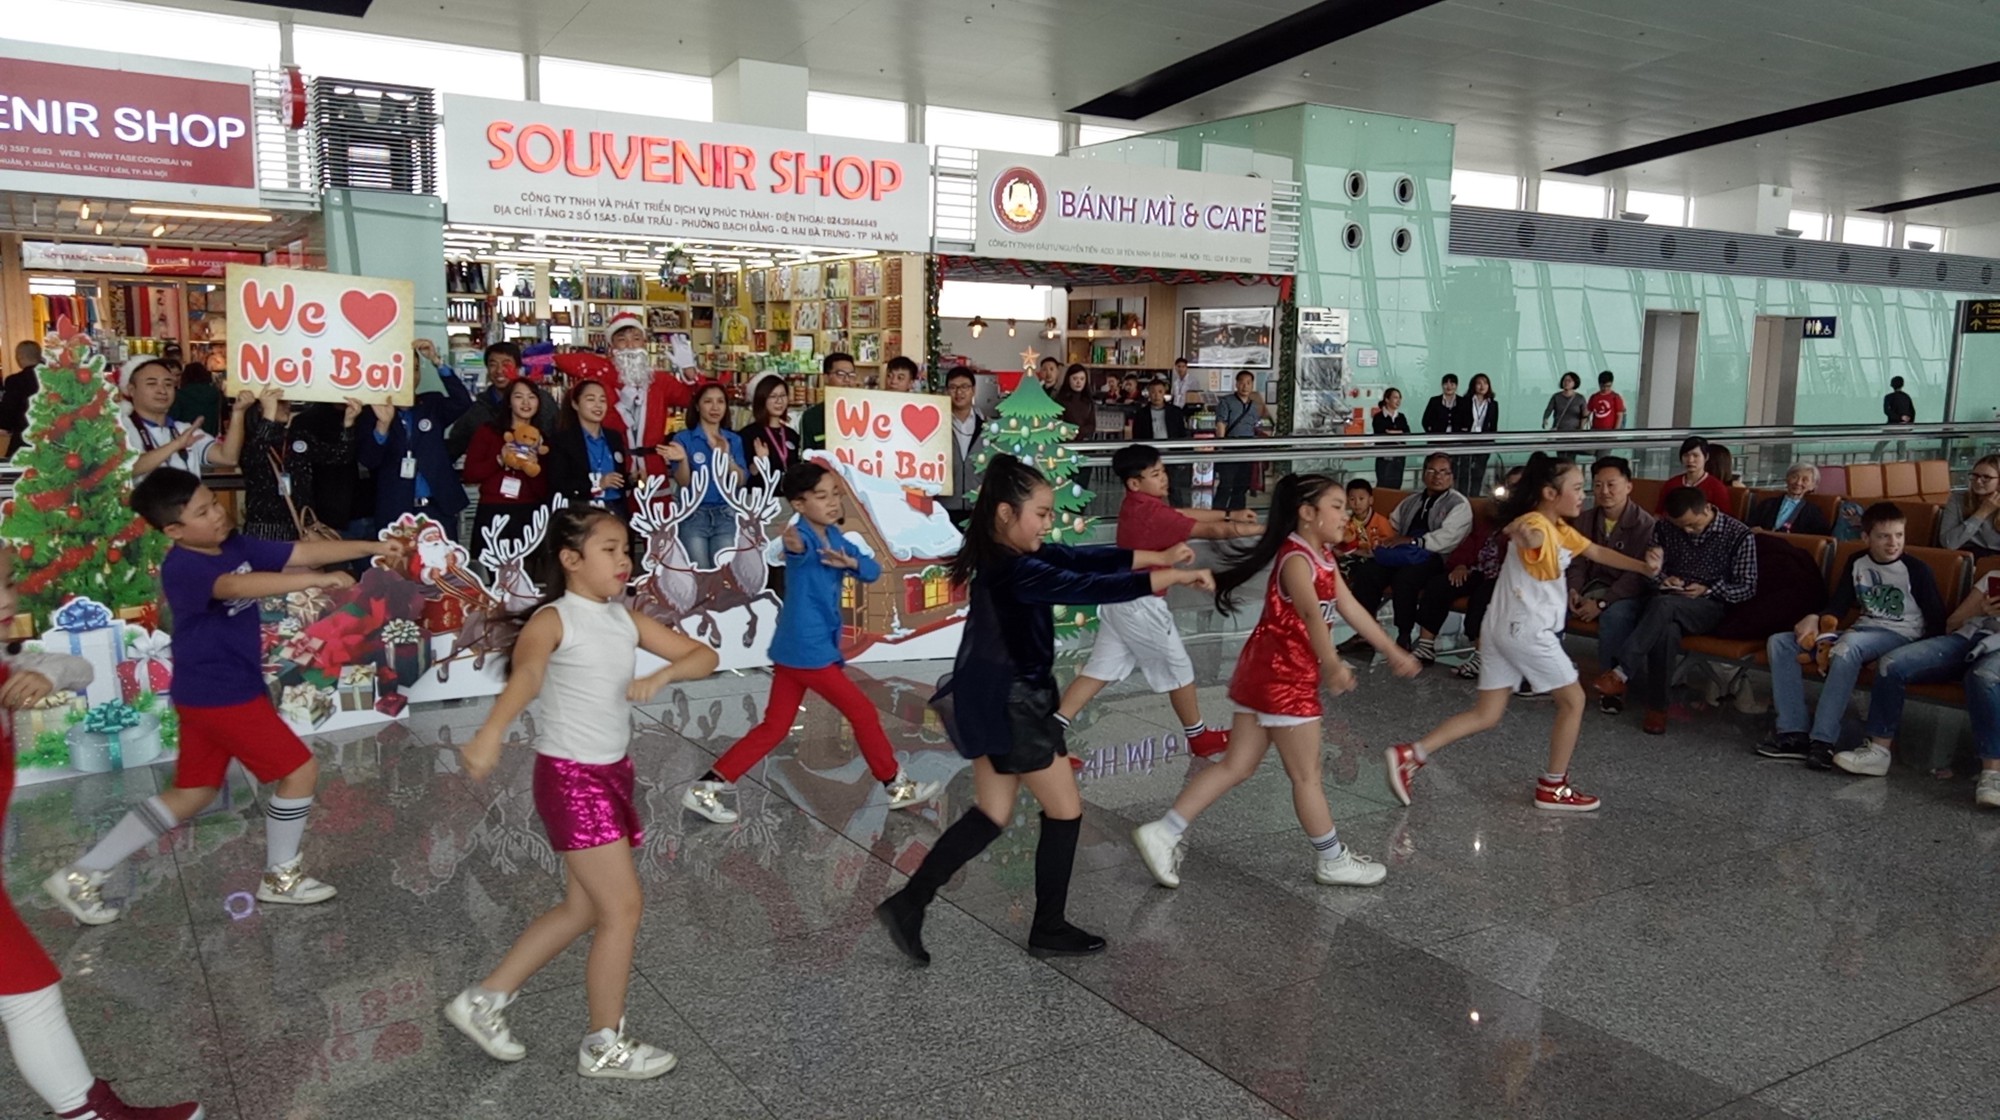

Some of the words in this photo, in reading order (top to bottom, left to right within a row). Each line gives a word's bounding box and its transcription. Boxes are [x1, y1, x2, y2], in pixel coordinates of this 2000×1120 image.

[113, 107, 246, 149] SHOP
[59, 149, 81, 158] WEB
[486, 121, 757, 191] SOUVENIR
[769, 149, 903, 201] SHOP
[493, 204, 512, 216] ĐỊA
[514, 204, 532, 216] CHỈ
[538, 206, 566, 219] TẦNG
[568, 210, 574, 219] 2
[576, 208, 591, 220] SỐ
[594, 212, 617, 223] 15A5
[722, 222, 748, 232] BẠCH
[791, 227, 806, 236] HAI
[808, 226, 820, 237] BÀ
[871, 230, 883, 241] HÀ
[884, 231, 899, 243] NỘI
[520, 191, 551, 204] CÔNG
[554, 195, 567, 205] TY
[569, 196, 597, 207] TNHH
[598, 197, 612, 209] VÀ
[614, 199, 641, 210] PHÁT
[644, 200, 671, 213] TRIỂN
[674, 204, 696, 215] DỊCH
[697, 206, 710, 217] VỤ
[712, 206, 737, 218] PHÚC
[740, 208, 770, 219] THÀNH
[775, 211, 796, 222] ĐIỆN
[1058, 185, 1138, 222] BÁNH
[1142, 194, 1177, 226] MÌ
[1182, 202, 1200, 229] &
[1204, 198, 1267, 234] CAFÉ
[988, 238, 1008, 248] CÔNG
[1008, 240, 1017, 248] TY
[1017, 241, 1035, 250] TNHH
[242, 280, 326, 335] We
[240, 342, 313, 386] Noi
[329, 347, 403, 390] Bai
[836, 398, 891, 439] We
[894, 450, 945, 482] Bai
